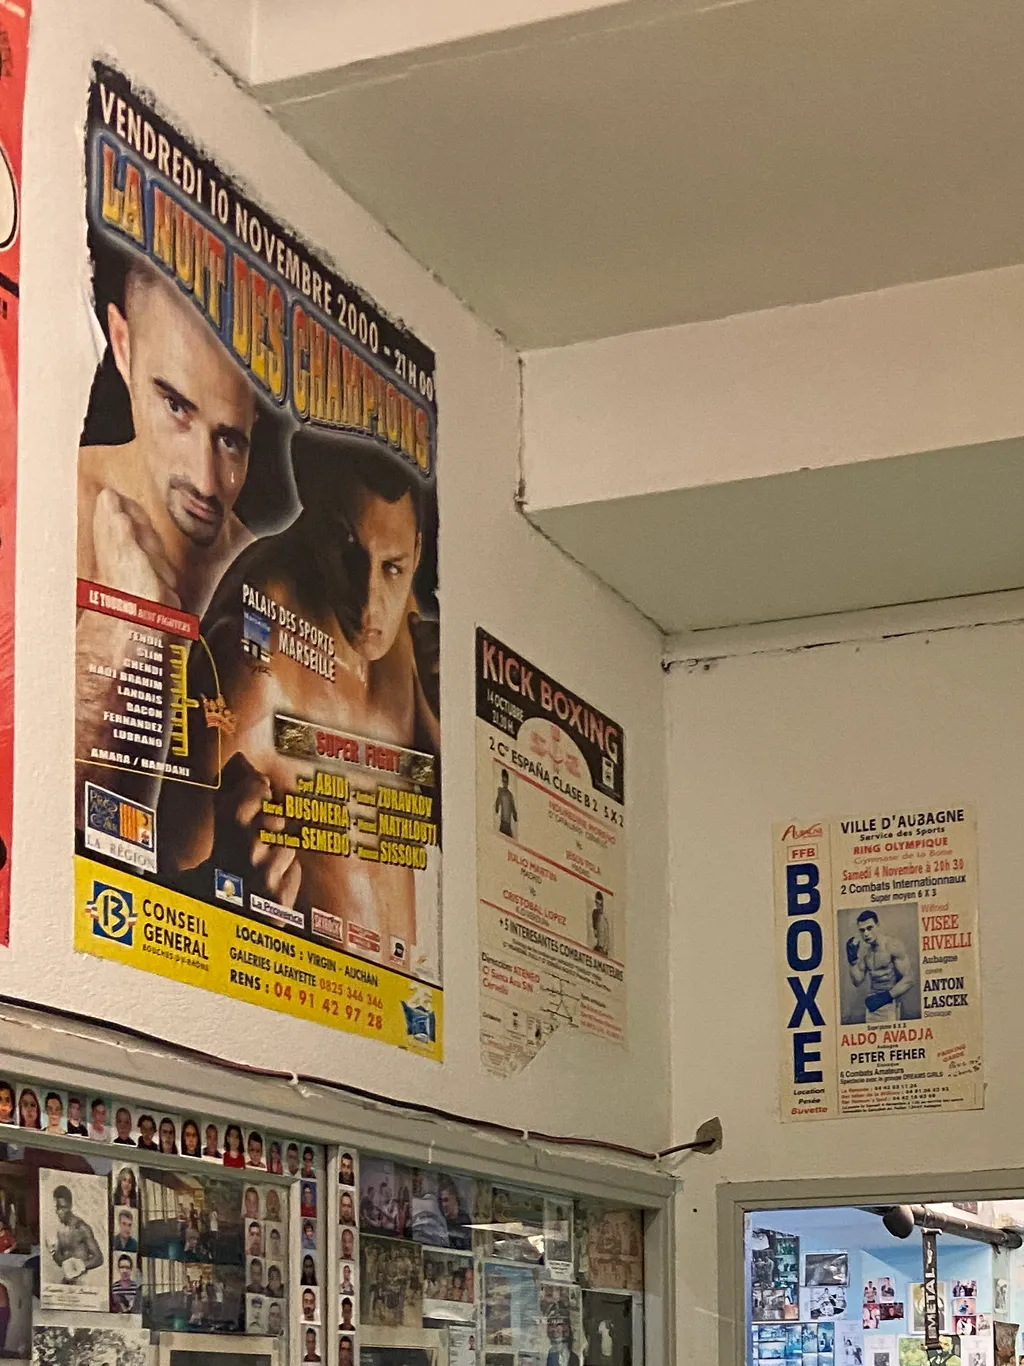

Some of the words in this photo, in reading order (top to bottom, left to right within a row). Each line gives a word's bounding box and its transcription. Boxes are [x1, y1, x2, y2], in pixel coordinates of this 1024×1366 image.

[100, 82, 203, 203] VENDREDI
[209, 178, 229, 225] 10
[236, 208, 332, 317] NOVEMBRE
[337, 295, 379, 352] 2000
[101, 143, 145, 242] LA
[152, 187, 226, 333] NUIT
[232, 252, 285, 402] DES
[292, 305, 432, 474] CHAMPIONS
[242, 584, 276, 621] PALAIS
[279, 606, 296, 632] DES
[299, 617, 335, 656] SPORTS
[278, 630, 336, 683] MARSEILLE
[118, 685, 163, 705] LANDAIS
[482, 639, 535, 701] KICK
[541, 679, 618, 764] BOXING
[104, 711, 163, 733] FERNANDEZ
[91, 748, 130, 765] AMARA
[316, 731, 359, 764] SUPER
[365, 741, 400, 773] FIGHT
[489, 736, 495, 751] 2
[511, 751, 551, 785] ESPAÑA
[552, 773, 582, 801] CLASE
[315, 772, 349, 801] ABIDI
[840, 819, 876, 834] VILLE
[881, 809, 965, 830] D'AUBAGNE
[859, 831, 893, 842] Service
[897, 829, 913, 838] des
[916, 826, 945, 838] Sports
[301, 831, 350, 856] SEMEDO
[378, 841, 427, 870] SISSOKO
[791, 848, 816, 860] FFB
[853, 844, 881, 855] RING
[884, 837, 948, 851] OLYMPIQUE
[842, 867, 872, 881] Samedi
[874, 866, 880, 877] 4
[882, 861, 923, 877] Novembre
[953, 858, 964, 871] 30
[841, 884, 847, 895] 2
[849, 879, 890, 894] Combats
[870, 892, 891, 904] Super
[893, 891, 916, 902] moyen
[142, 899, 208, 937] CONSEIL
[263, 902, 302, 925] Provence
[921, 914, 959, 932] VISEE
[144, 923, 208, 960] GENERAL
[922, 931, 972, 951] RIVELLI
[236, 924, 295, 957] LOCATIONS
[307, 950, 336, 972] VIRGIN
[344, 965, 378, 987] AUCHAN
[922, 954, 958, 965] Aubagne
[229, 947, 271, 971] GALERIES
[273, 961, 317, 987] LAFAYETTE
[319, 978, 343, 994] 0825
[786, 863, 826, 1084] BOXE
[923, 977, 964, 992] ANTON
[230, 969, 261, 991] RENS
[274, 982, 292, 1001] 04
[300, 990, 315, 1008] 91
[322, 998, 339, 1016] 42
[345, 1005, 361, 1022] 97
[367, 1013, 383, 1030] 28
[923, 993, 969, 1009] LASCEK
[841, 1032, 877, 1047] ALDO
[883, 1028, 934, 1045] AVADJA
[850, 1050, 885, 1064] PETER
[890, 1048, 925, 1061] FEHER
[845, 1069, 873, 1078] Combats
[874, 1067, 905, 1076] Amateurs
[794, 1087, 825, 1096] Location
[791, 1106, 828, 1115] Buvette
